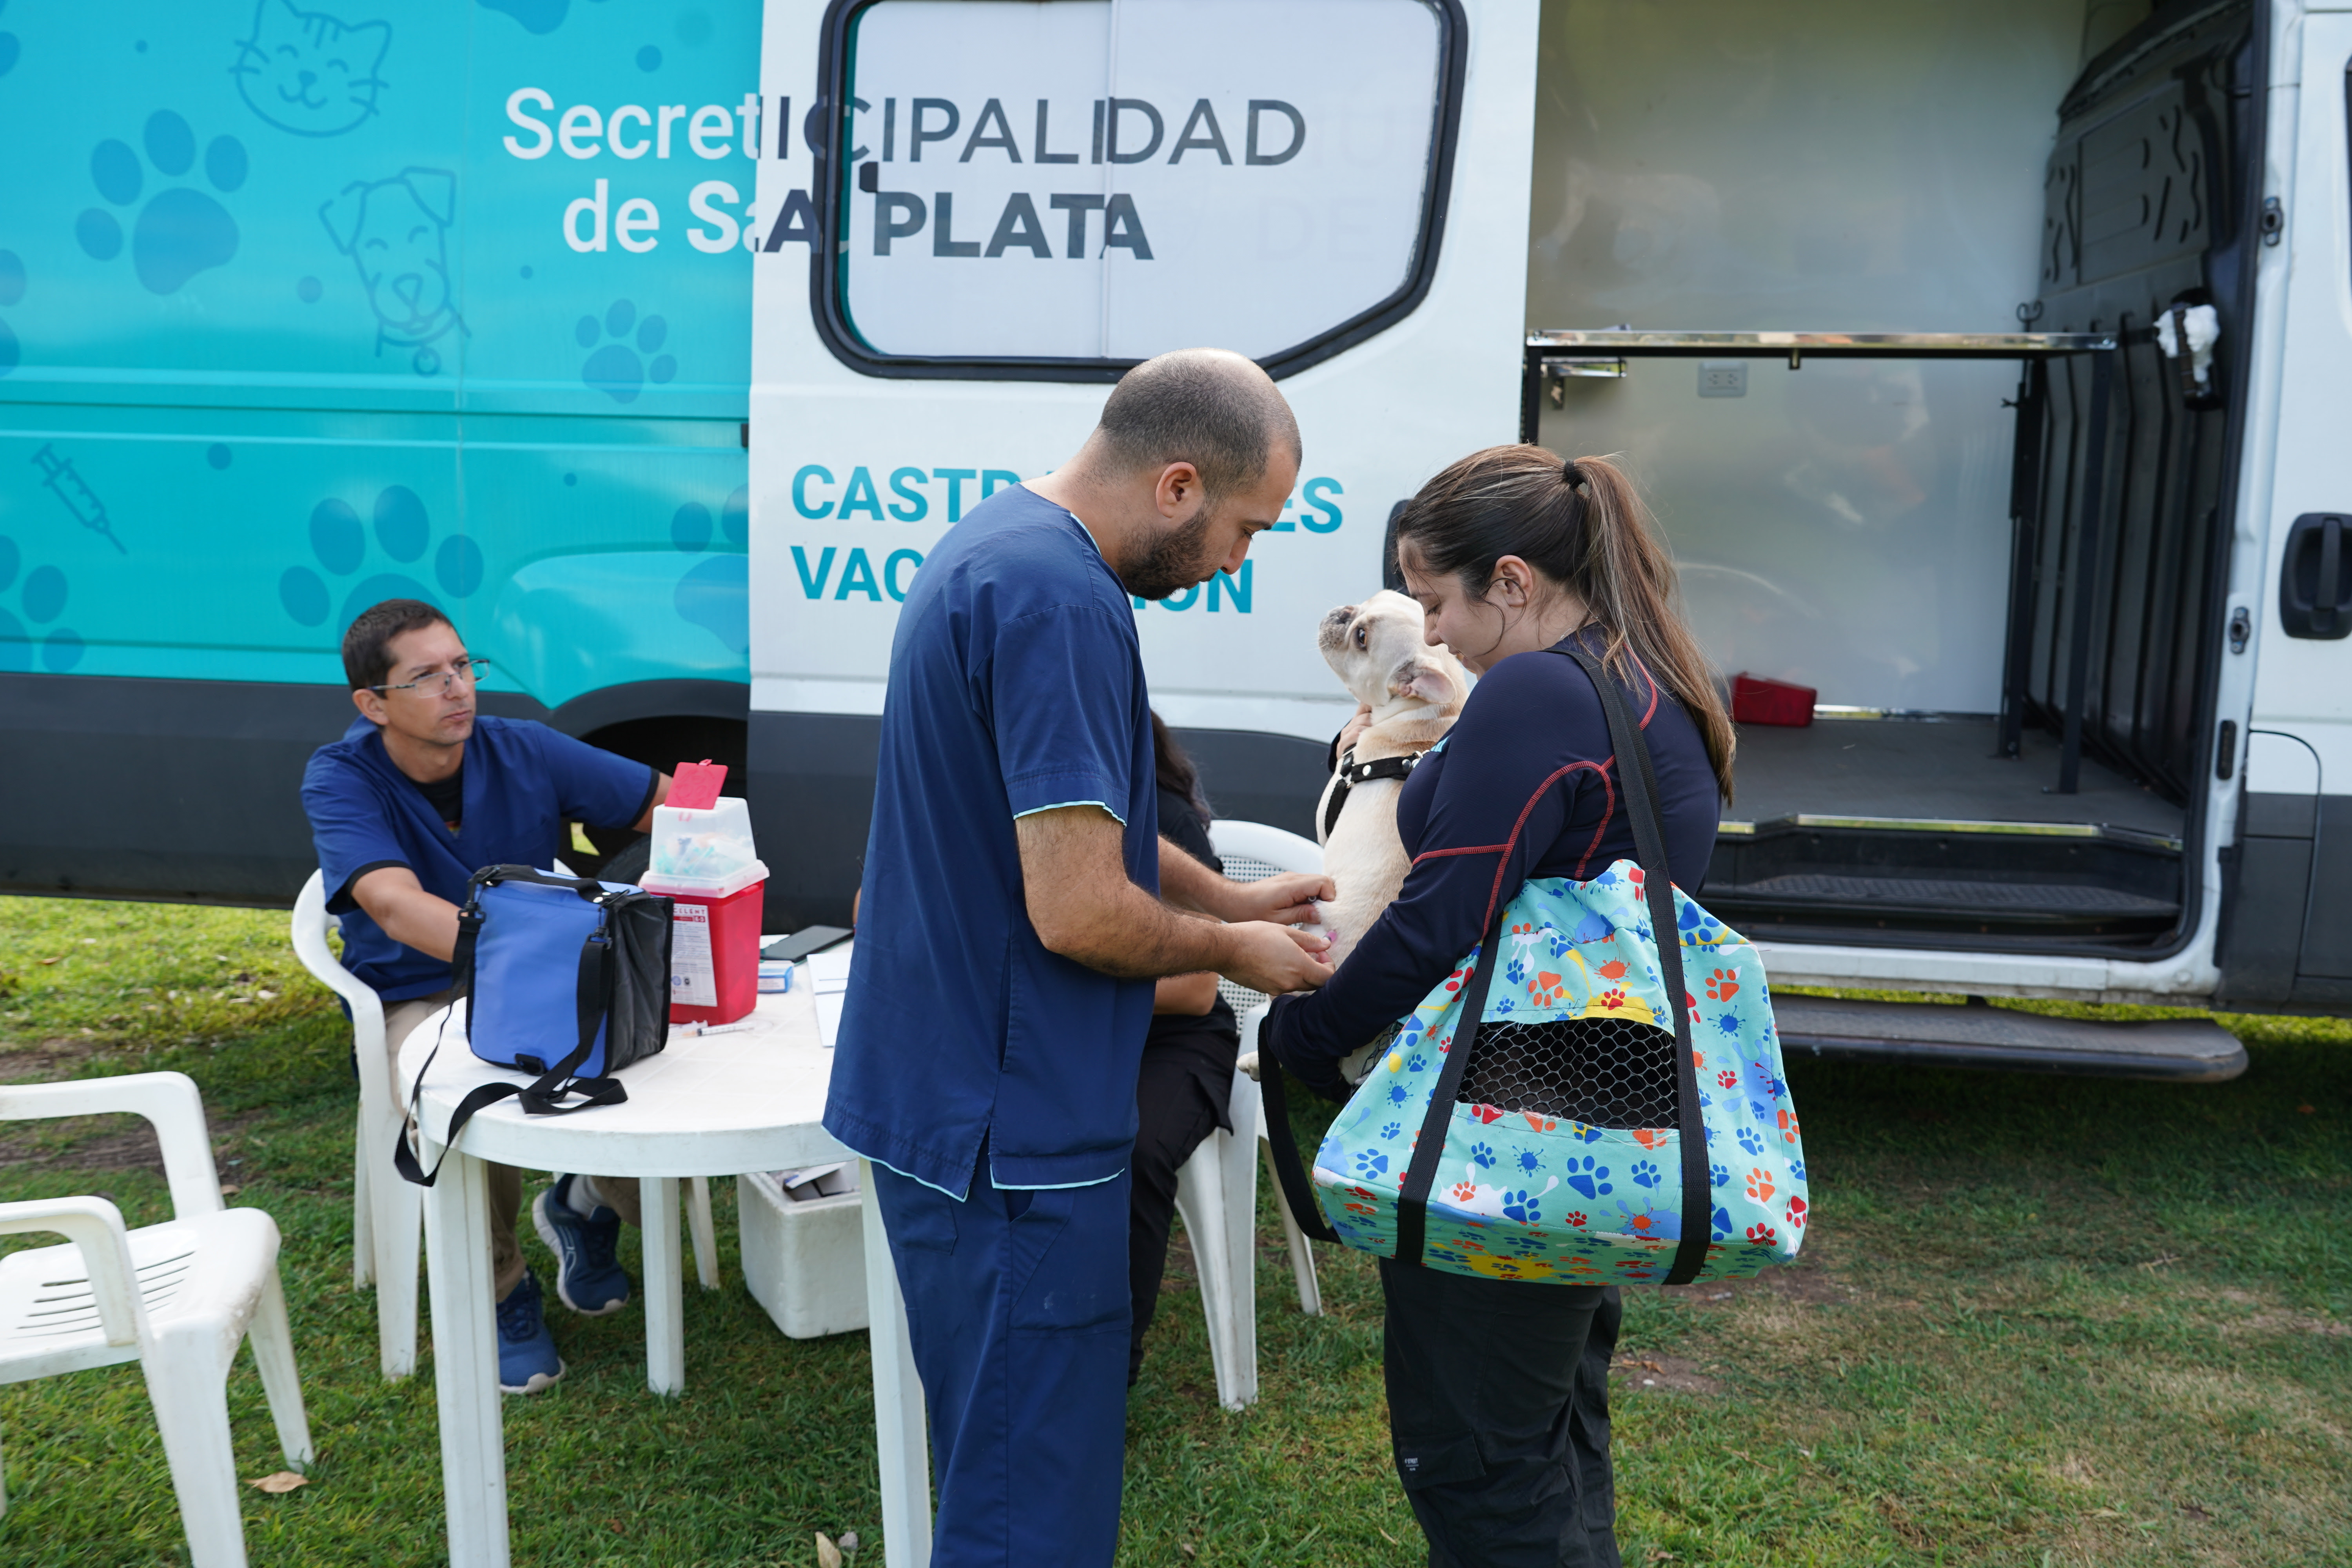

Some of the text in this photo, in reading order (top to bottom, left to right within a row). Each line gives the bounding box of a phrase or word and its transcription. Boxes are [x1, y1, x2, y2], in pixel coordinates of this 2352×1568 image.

[758, 96, 1306, 166] ICIPALIDAD
[563, 178, 660, 253] de
[873, 190, 1155, 260] PLATA
